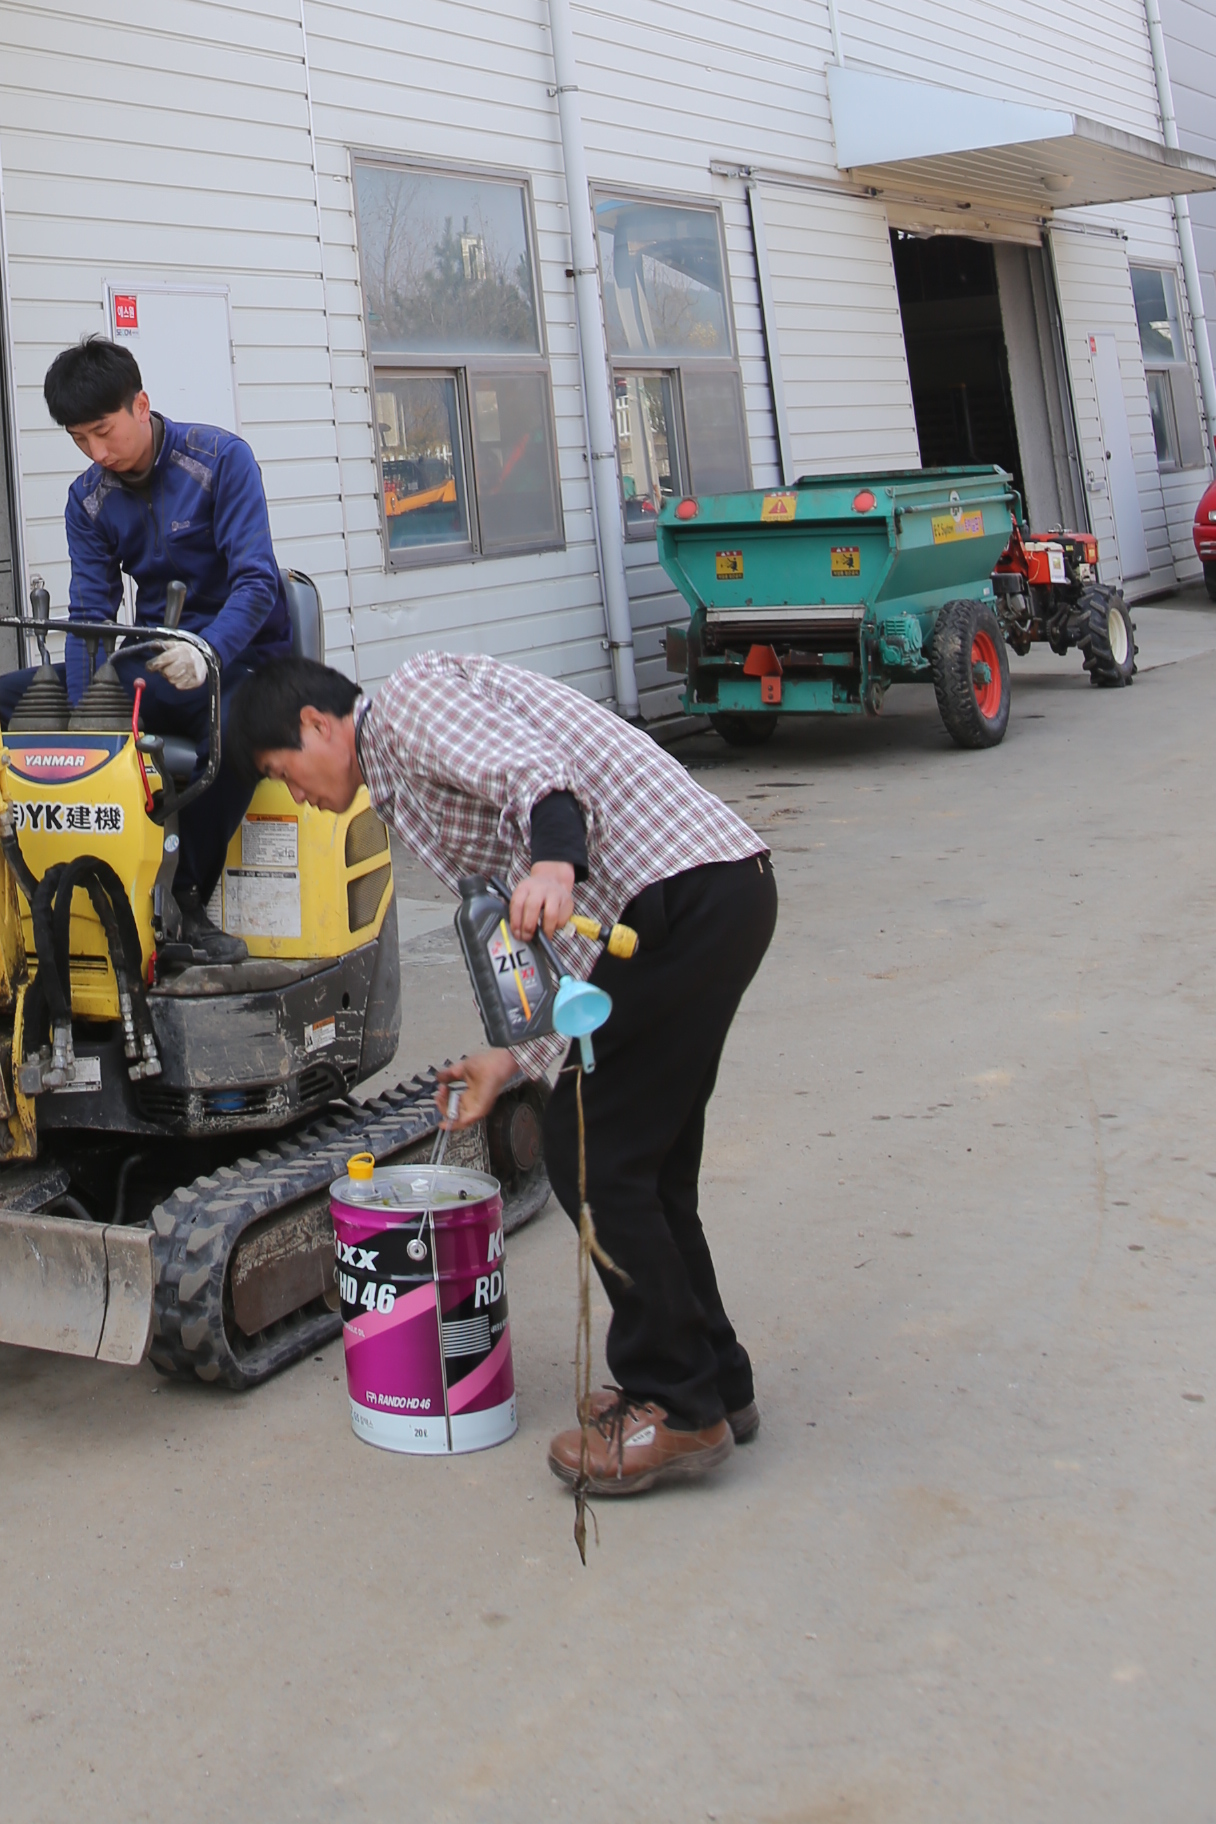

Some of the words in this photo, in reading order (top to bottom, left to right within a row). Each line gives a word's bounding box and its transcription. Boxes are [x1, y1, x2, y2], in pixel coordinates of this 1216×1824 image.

[116, 305, 135, 319] 에스원
[25, 755, 85, 767] YANMAR
[495, 948, 530, 974] ZIC
[521, 966, 535, 980] X7
[339, 1270, 358, 1305] HD
[360, 1281, 397, 1314] 46
[378, 1393, 406, 1409] RANDO
[406, 1397, 420, 1410] HD
[420, 1397, 432, 1410] 46
